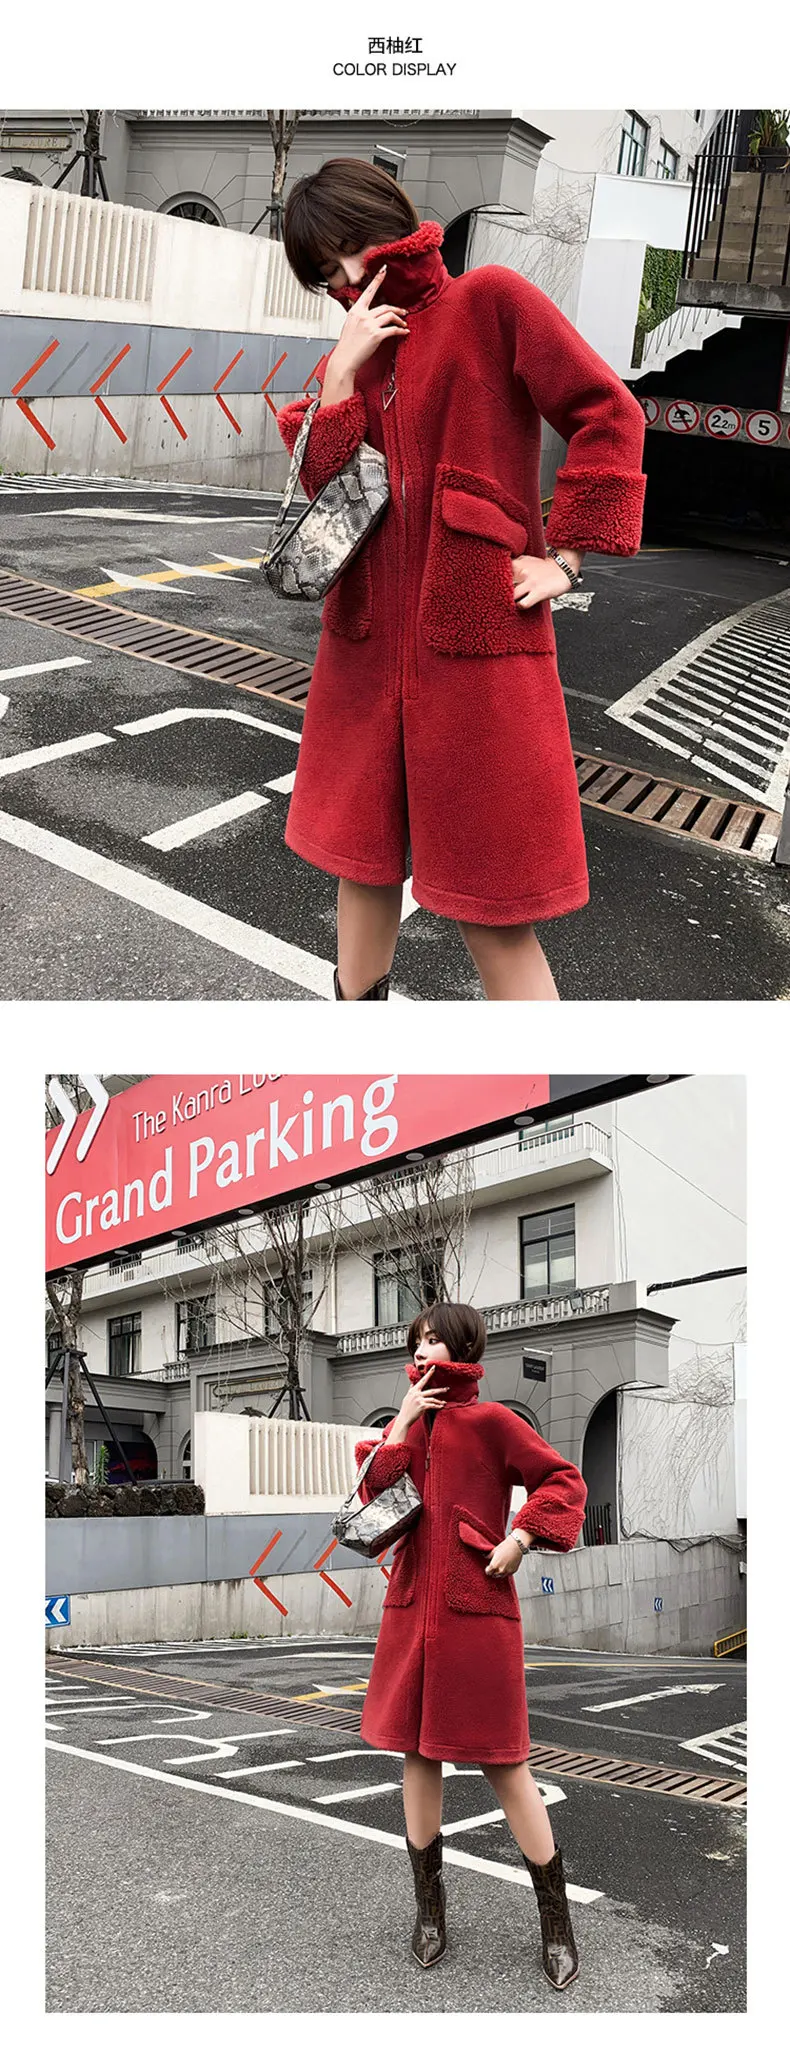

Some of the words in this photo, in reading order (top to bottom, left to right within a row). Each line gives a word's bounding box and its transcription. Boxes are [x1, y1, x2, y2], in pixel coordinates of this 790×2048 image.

[758, 420, 771, 435] 5
[132, 1110, 167, 1143] The
[172, 1079, 232, 1126] Kanra
[55, 1146, 173, 1244] Grand
[188, 1074, 399, 1199] Parking
